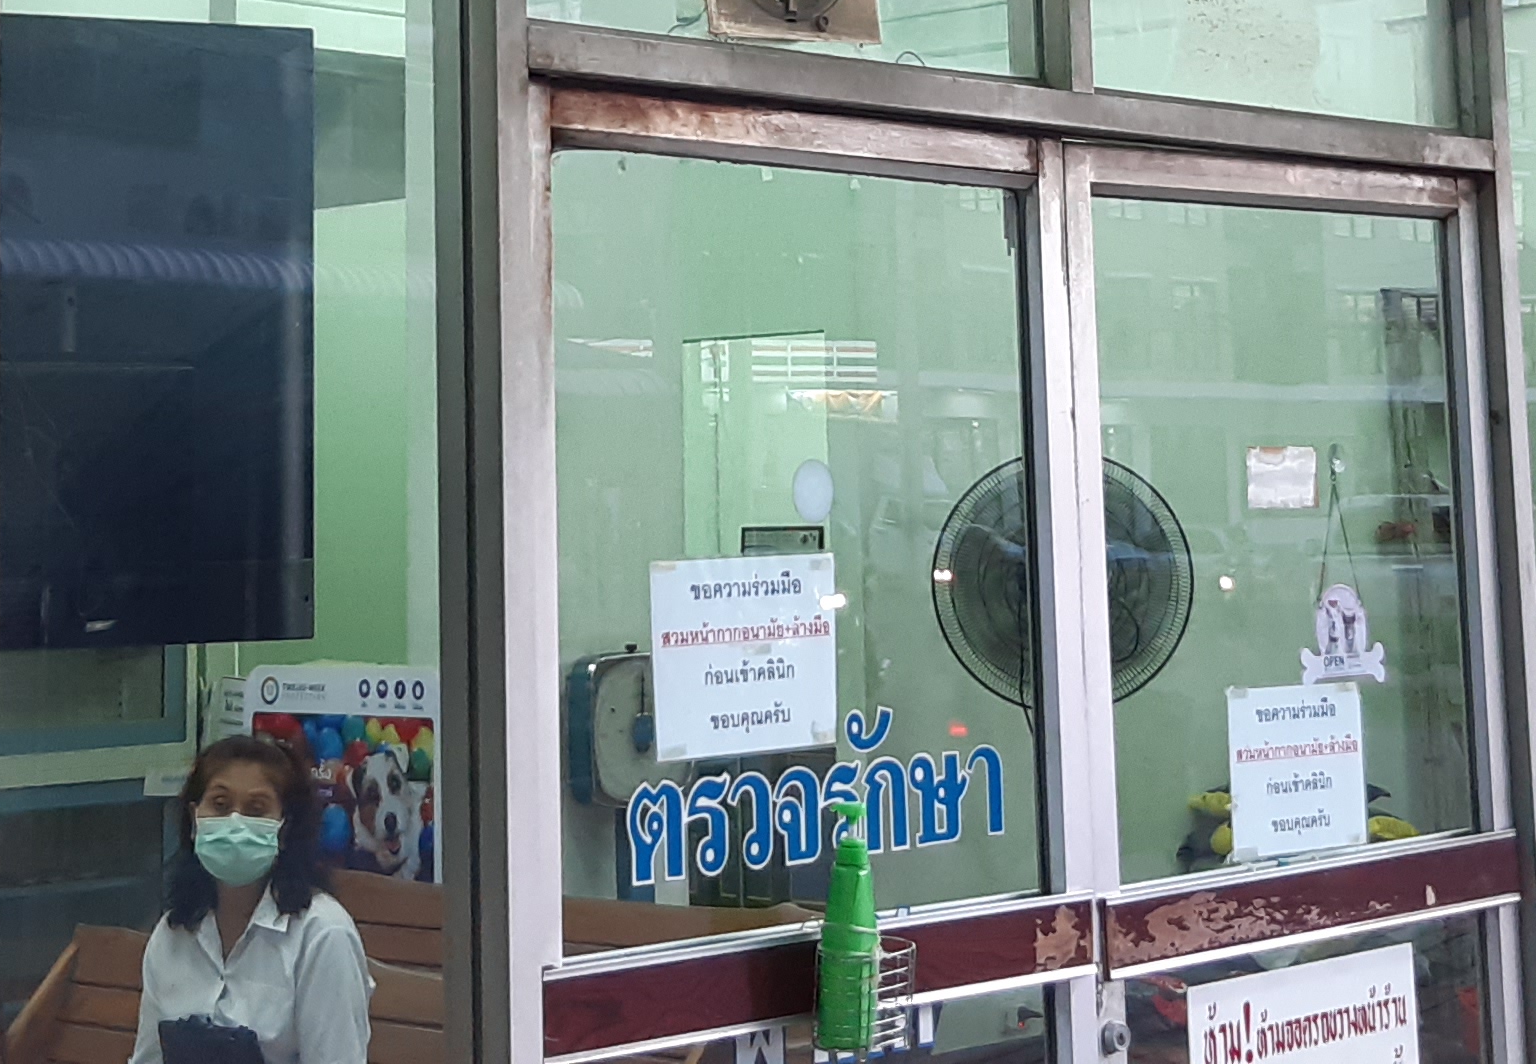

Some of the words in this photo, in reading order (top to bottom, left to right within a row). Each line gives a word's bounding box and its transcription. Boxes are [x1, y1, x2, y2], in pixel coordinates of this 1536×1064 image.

[690, 570, 802, 601] ขอความร่วมมือ
[704, 657, 795, 686] ก่อนเข้าคลินิก
[710, 701, 791, 733] ขอบคุณครับ
[1255, 697, 1337, 723] ขอความร่วมมือ
[626, 705, 1006, 886] ตรวจรักษา
[1271, 808, 1331, 835] ขอบคุณครับ
